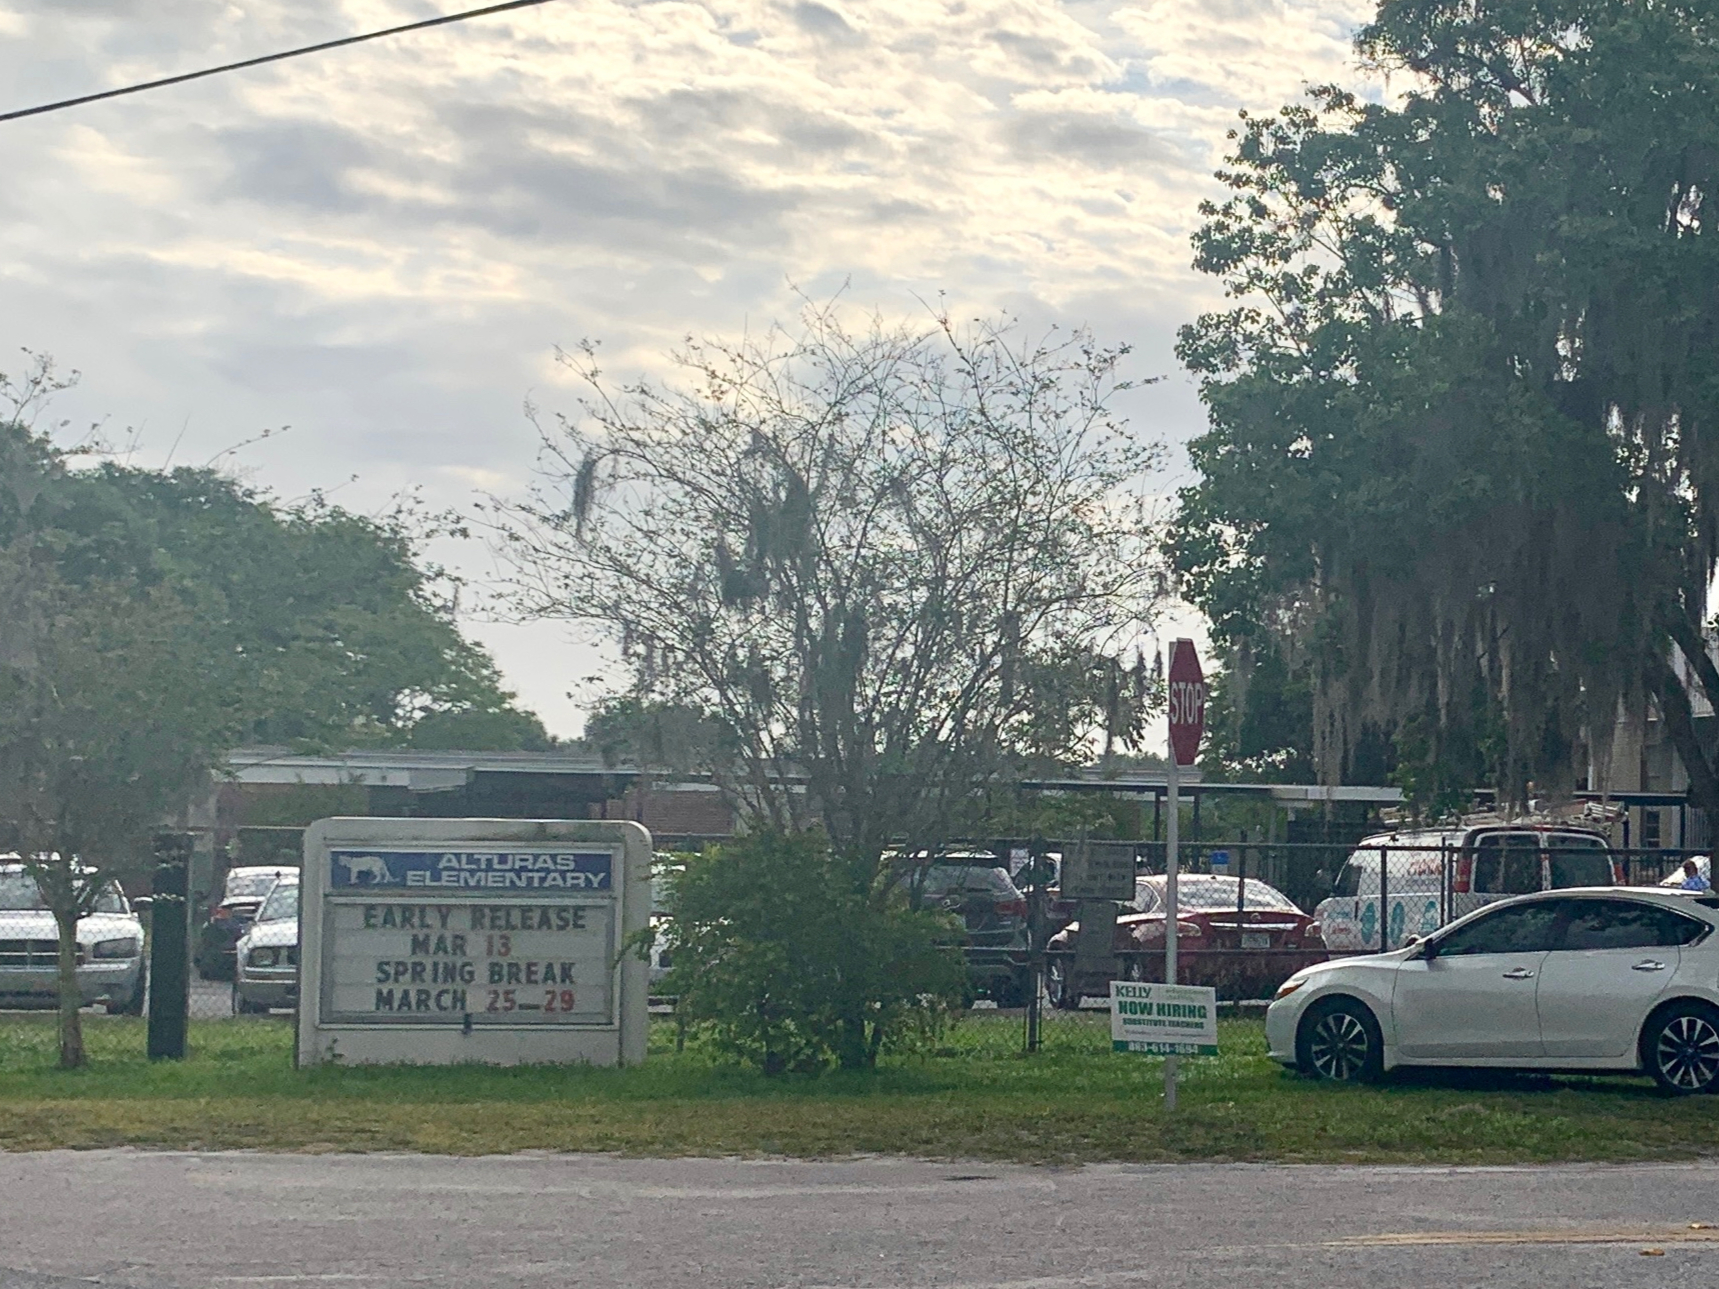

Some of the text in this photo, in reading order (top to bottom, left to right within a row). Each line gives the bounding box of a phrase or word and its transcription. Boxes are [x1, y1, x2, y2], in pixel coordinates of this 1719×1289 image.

[1171, 682, 1202, 725] STOP
[437, 853, 576, 870] ALTURAS
[406, 870, 605, 888] ELEMENTARY
[364, 908, 586, 931] EARLY RELEASE
[410, 934, 512, 956] MAR 13
[376, 962, 576, 985] SPRING BREAK
[375, 988, 467, 1011] MARCH
[1115, 985, 1152, 998] KELLY
[1118, 1001, 1207, 1018] NOW HIRING
